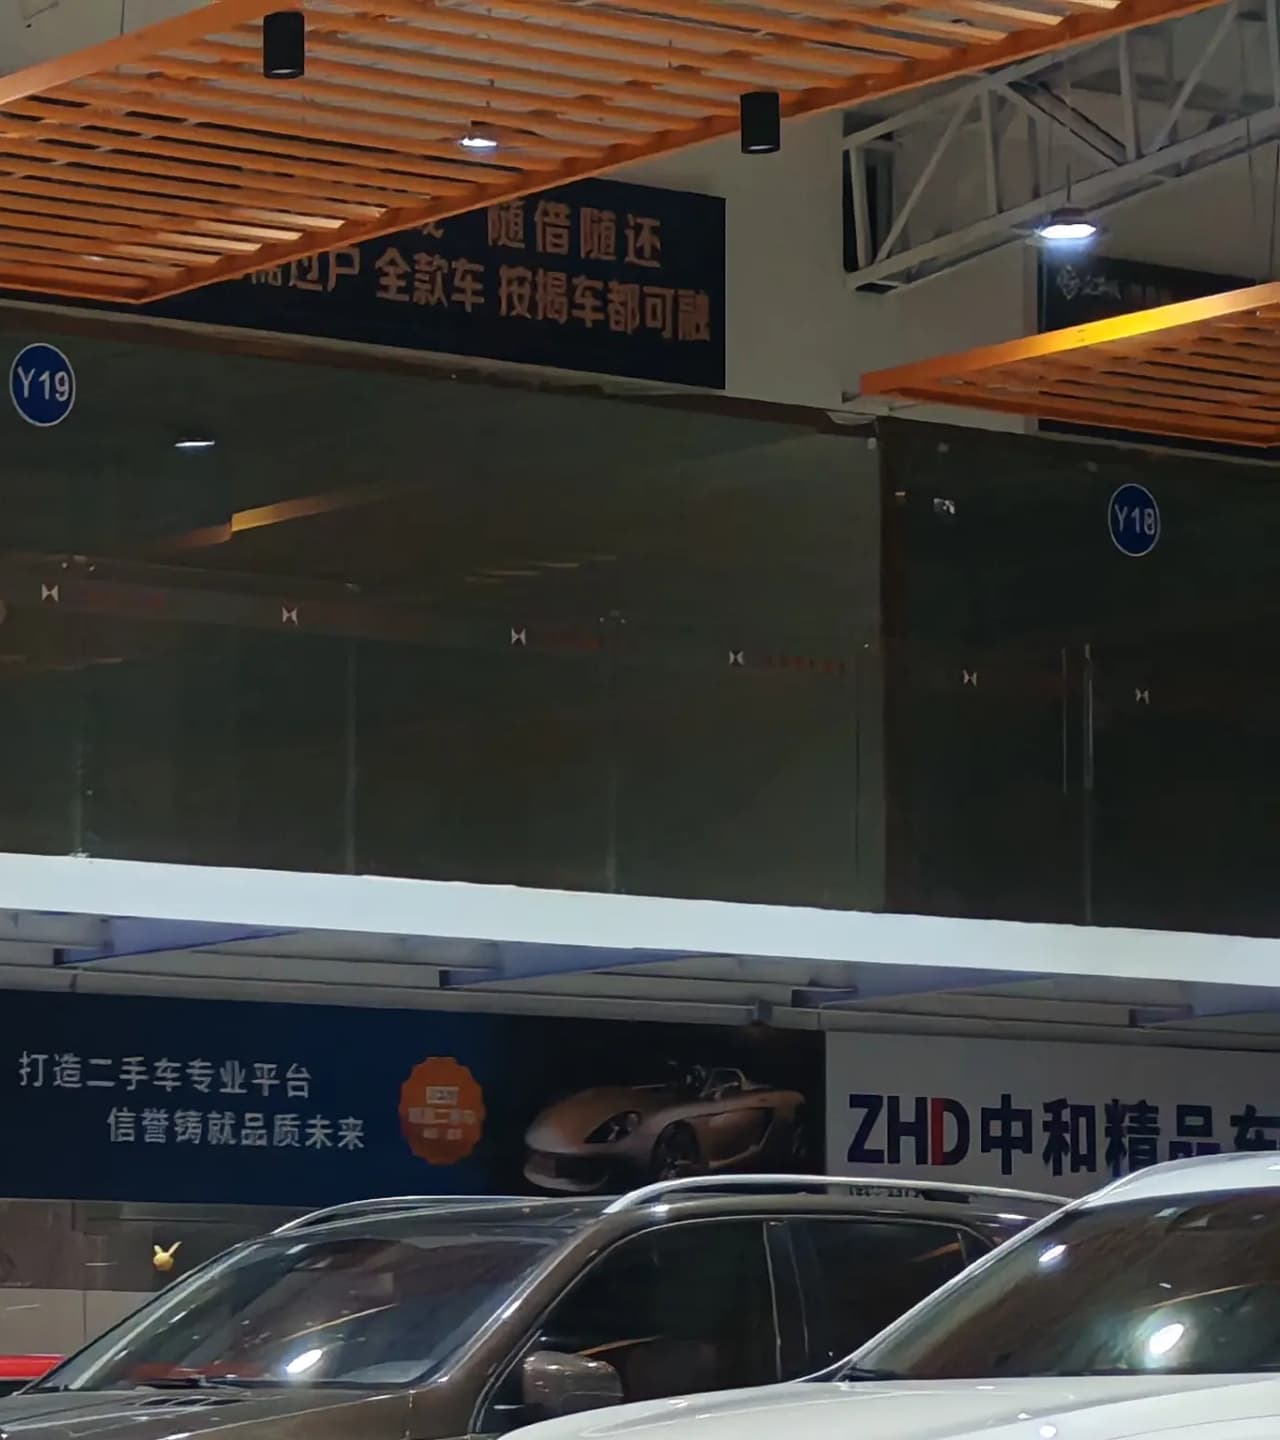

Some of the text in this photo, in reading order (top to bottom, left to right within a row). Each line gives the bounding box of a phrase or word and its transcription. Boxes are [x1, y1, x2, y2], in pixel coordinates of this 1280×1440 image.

[487, 200, 662, 269] 随借随还
[373, 247, 485, 313] 全款车
[17, 365, 70, 402] Y19
[1114, 504, 1156, 536] Y18
[18, 1051, 313, 1099] 打造二手车专业平台
[107, 1107, 366, 1151] 信誉铸就品质未来
[847, 1093, 971, 1166] ZHD
